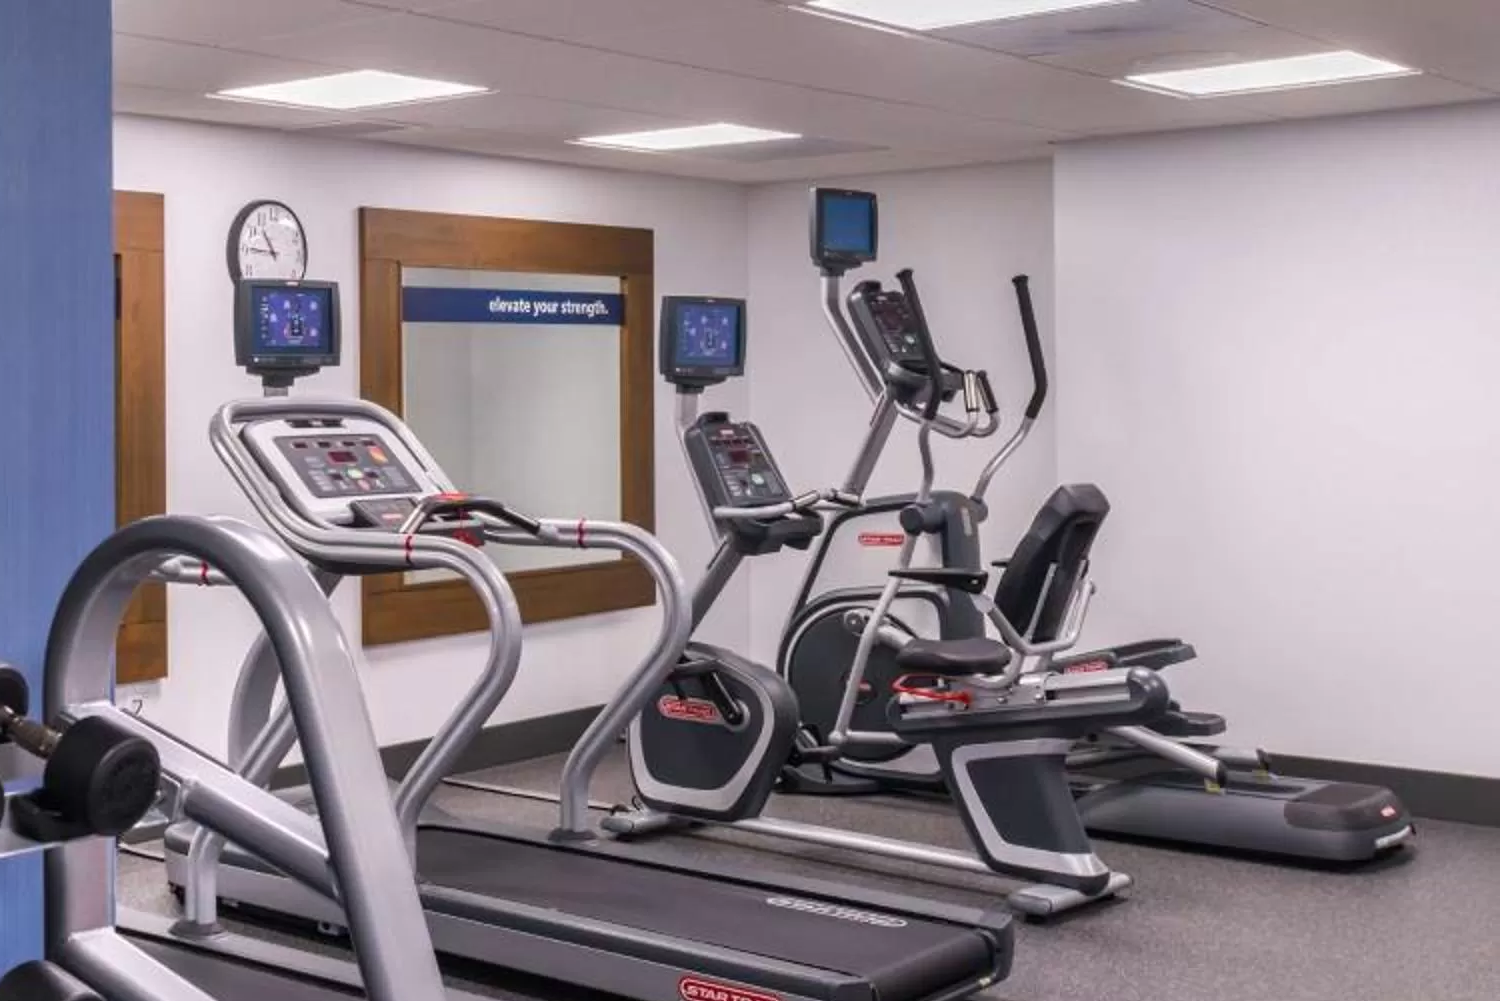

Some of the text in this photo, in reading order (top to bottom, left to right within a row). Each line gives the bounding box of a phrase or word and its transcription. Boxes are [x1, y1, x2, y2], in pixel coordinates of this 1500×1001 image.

[489, 296, 609, 318] elevate your strength.
